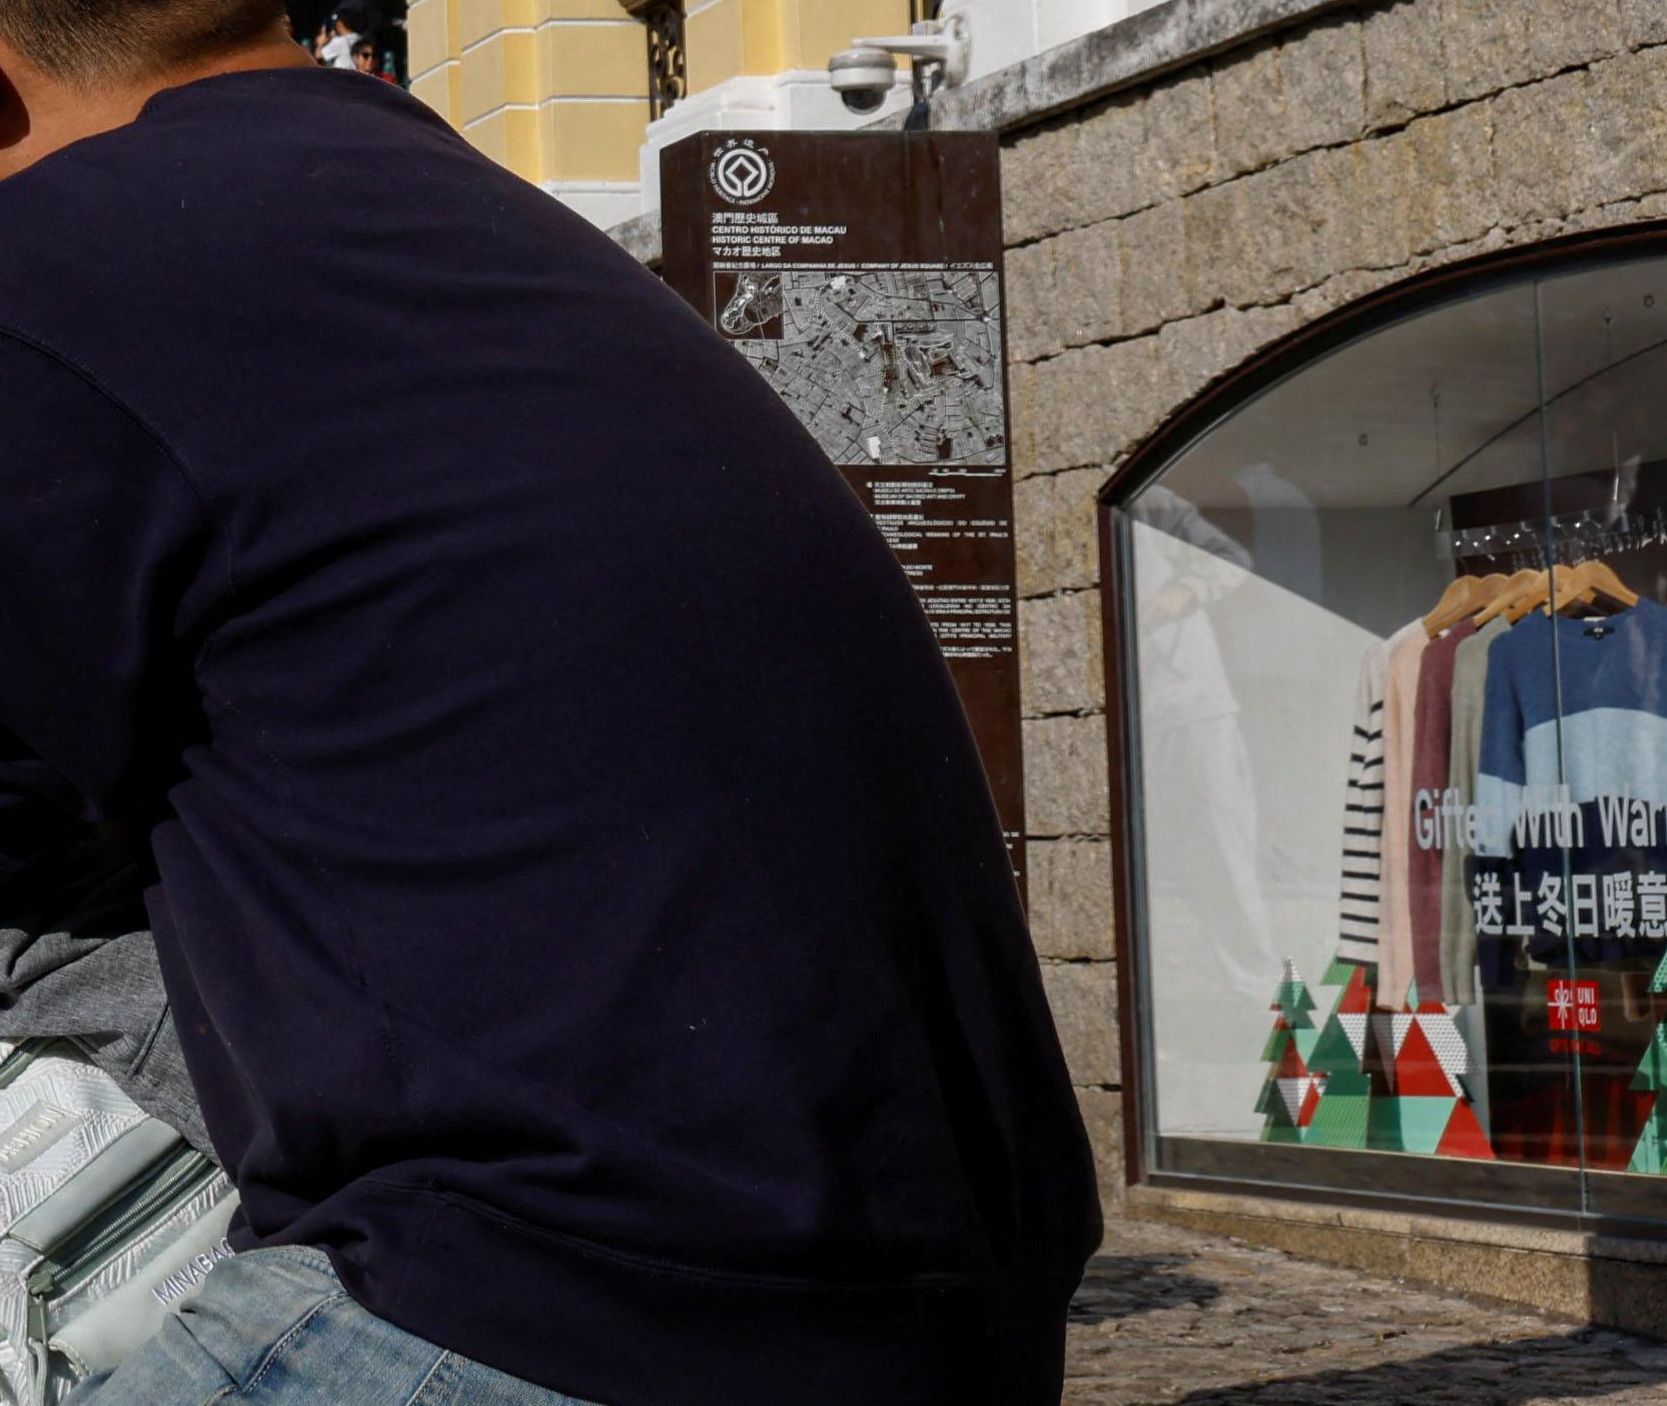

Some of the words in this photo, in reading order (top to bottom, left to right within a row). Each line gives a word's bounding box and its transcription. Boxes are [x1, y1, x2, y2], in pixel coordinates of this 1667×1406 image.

[712, 226, 749, 234] CENTRO
[751, 225, 798, 234] HISTÓRICO
[800, 226, 812, 234] DE
[815, 226, 846, 234] MACAU
[712, 236, 751, 244] HISTORIC
[753, 236, 786, 244] CENTRE
[788, 236, 799, 244] OF
[802, 236, 833, 244] MACAO
[1515, 783, 1584, 849] With
[1597, 790, 1667, 848] War
[1474, 870, 1667, 939] 送上冬日暖意
[1578, 987, 1594, 1004] UNI
[1579, 1007, 1597, 1027] QLO
